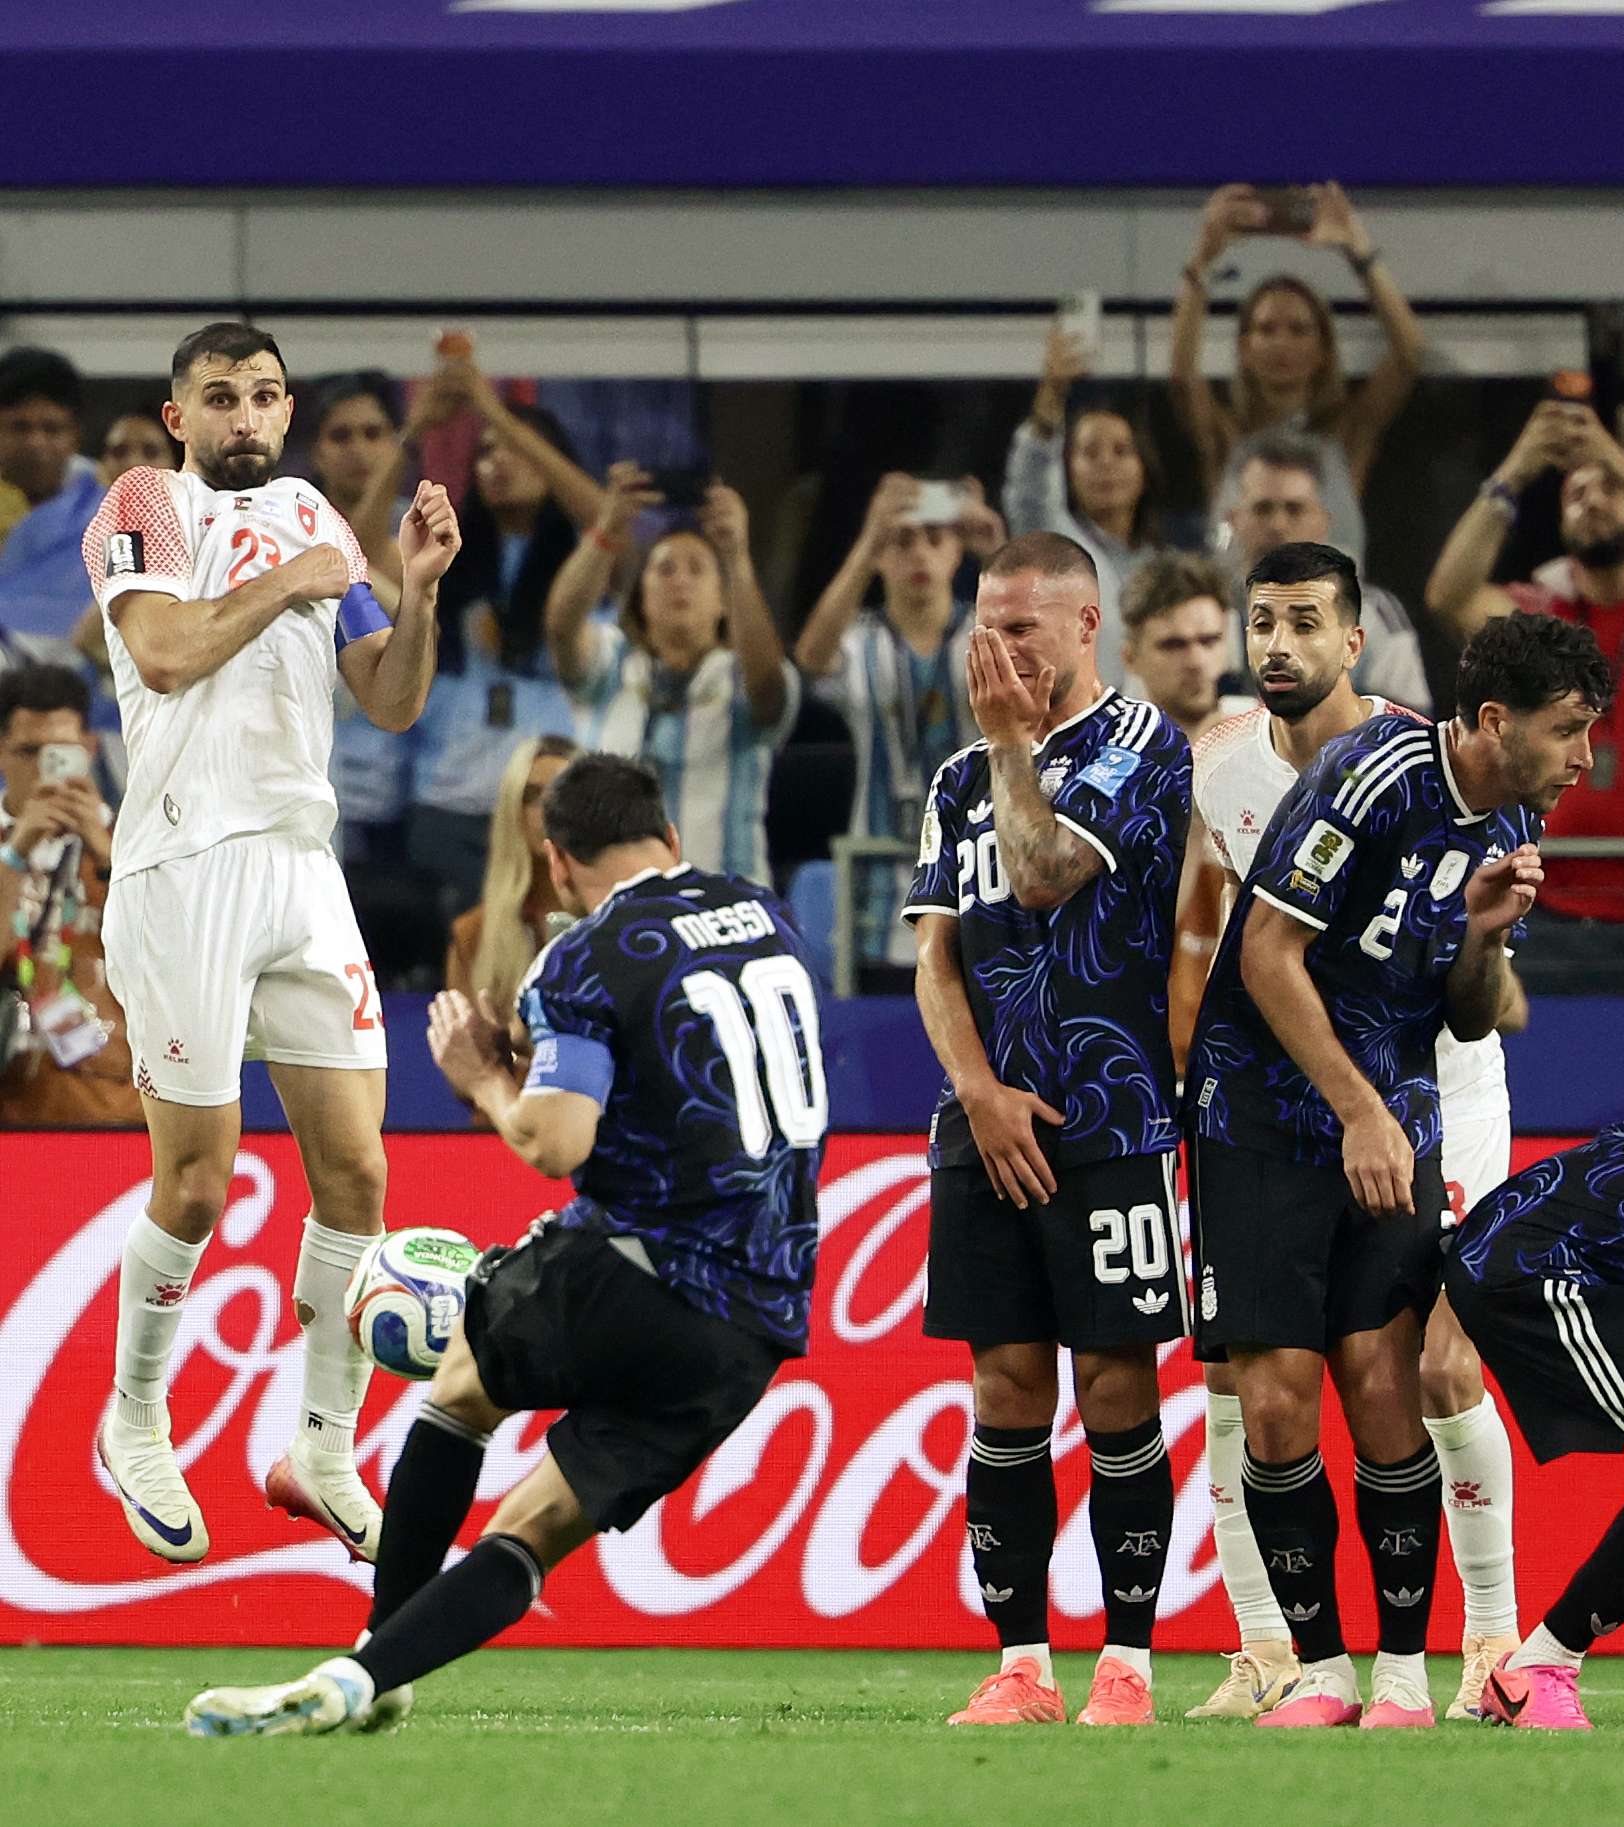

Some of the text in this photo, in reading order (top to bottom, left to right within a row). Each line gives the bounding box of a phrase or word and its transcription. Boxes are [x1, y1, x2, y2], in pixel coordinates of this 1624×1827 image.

[1236, 827, 1261, 835] KELME
[956, 829, 1012, 916] 20
[670, 898, 776, 951] MESSI
[1359, 888, 1409, 962] 2
[680, 953, 829, 1161] 10
[1088, 1203, 1169, 1284] 20
[145, 1295, 187, 1307] KEL
[0, 1150, 1250, 1617] CocCoa
